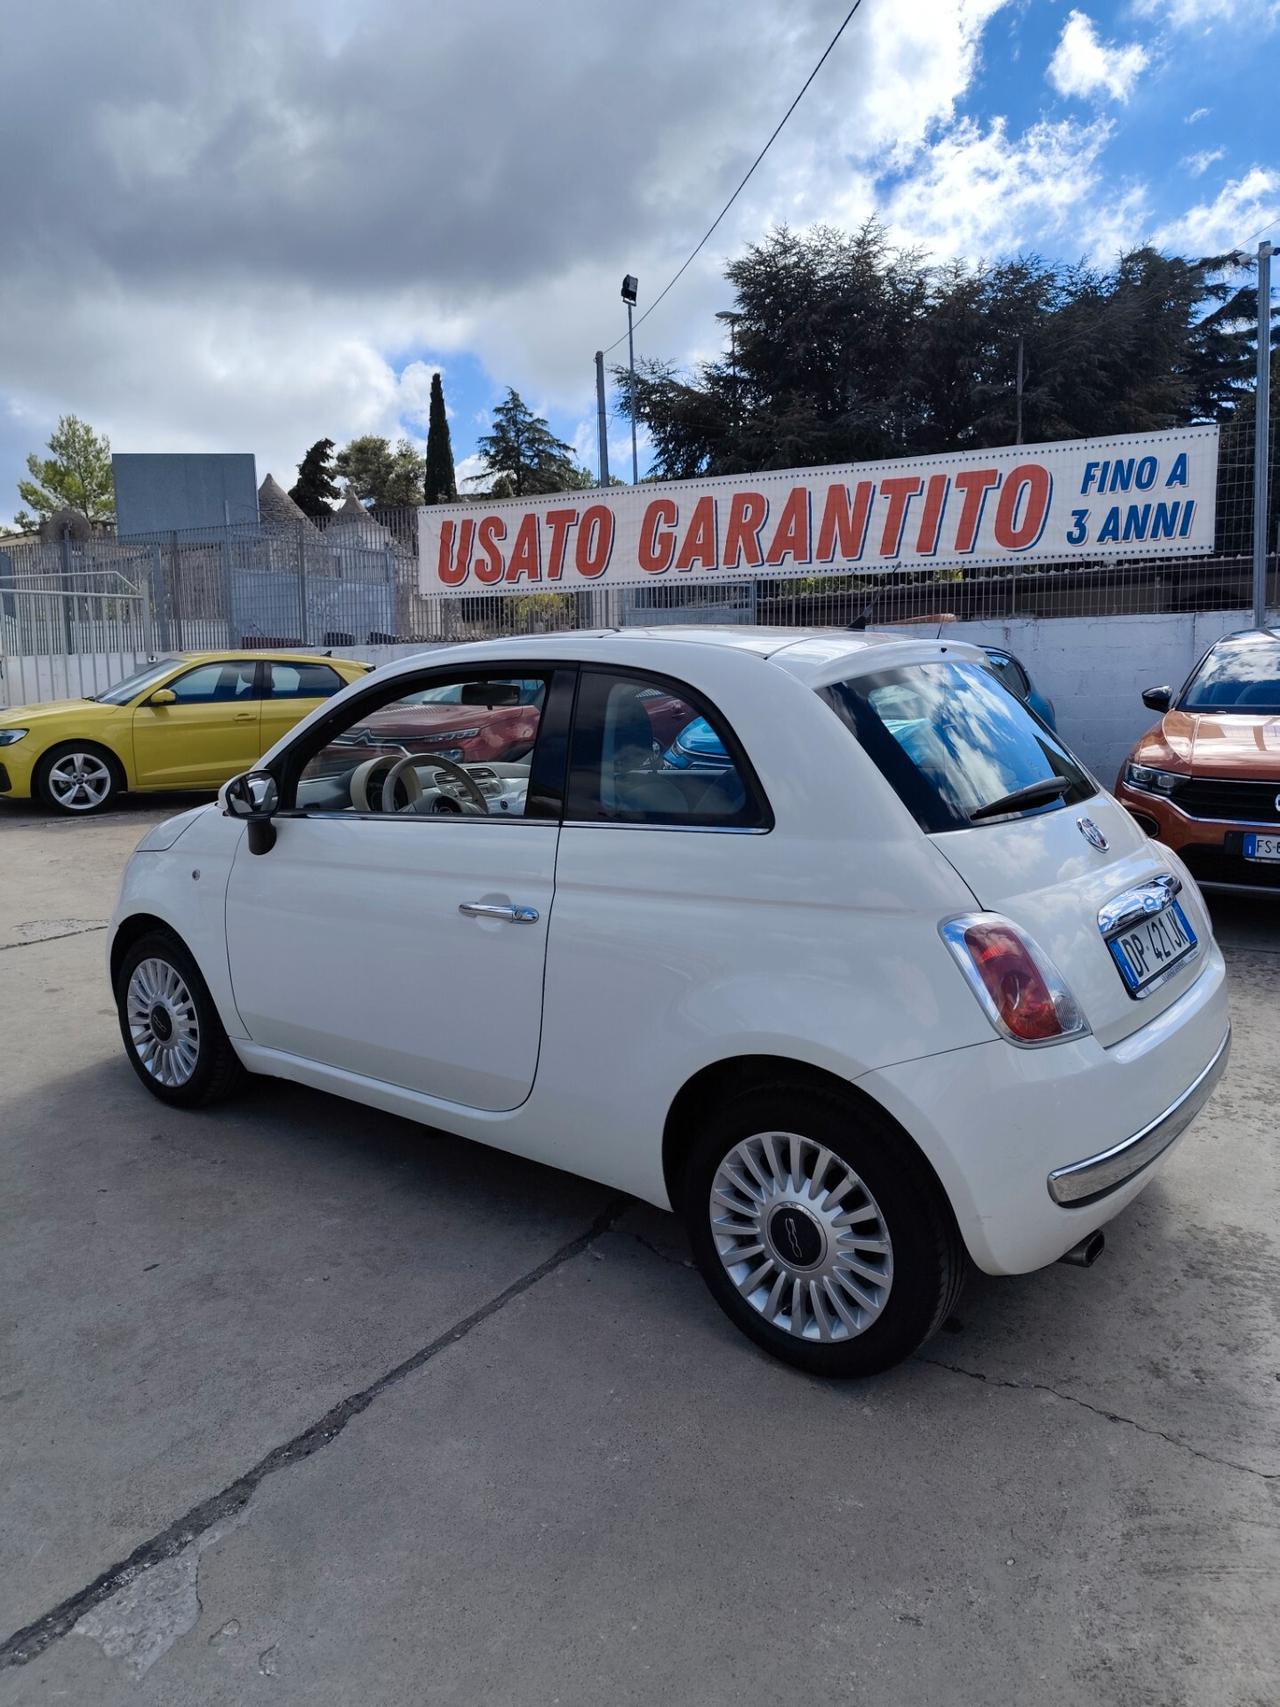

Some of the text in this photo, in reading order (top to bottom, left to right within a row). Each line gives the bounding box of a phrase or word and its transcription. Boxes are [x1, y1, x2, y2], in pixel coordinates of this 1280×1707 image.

[1081, 452, 1189, 495] FINO A
[438, 464, 1052, 585] USATO GARANTITO
[1066, 500, 1196, 545] 3 ANNI
